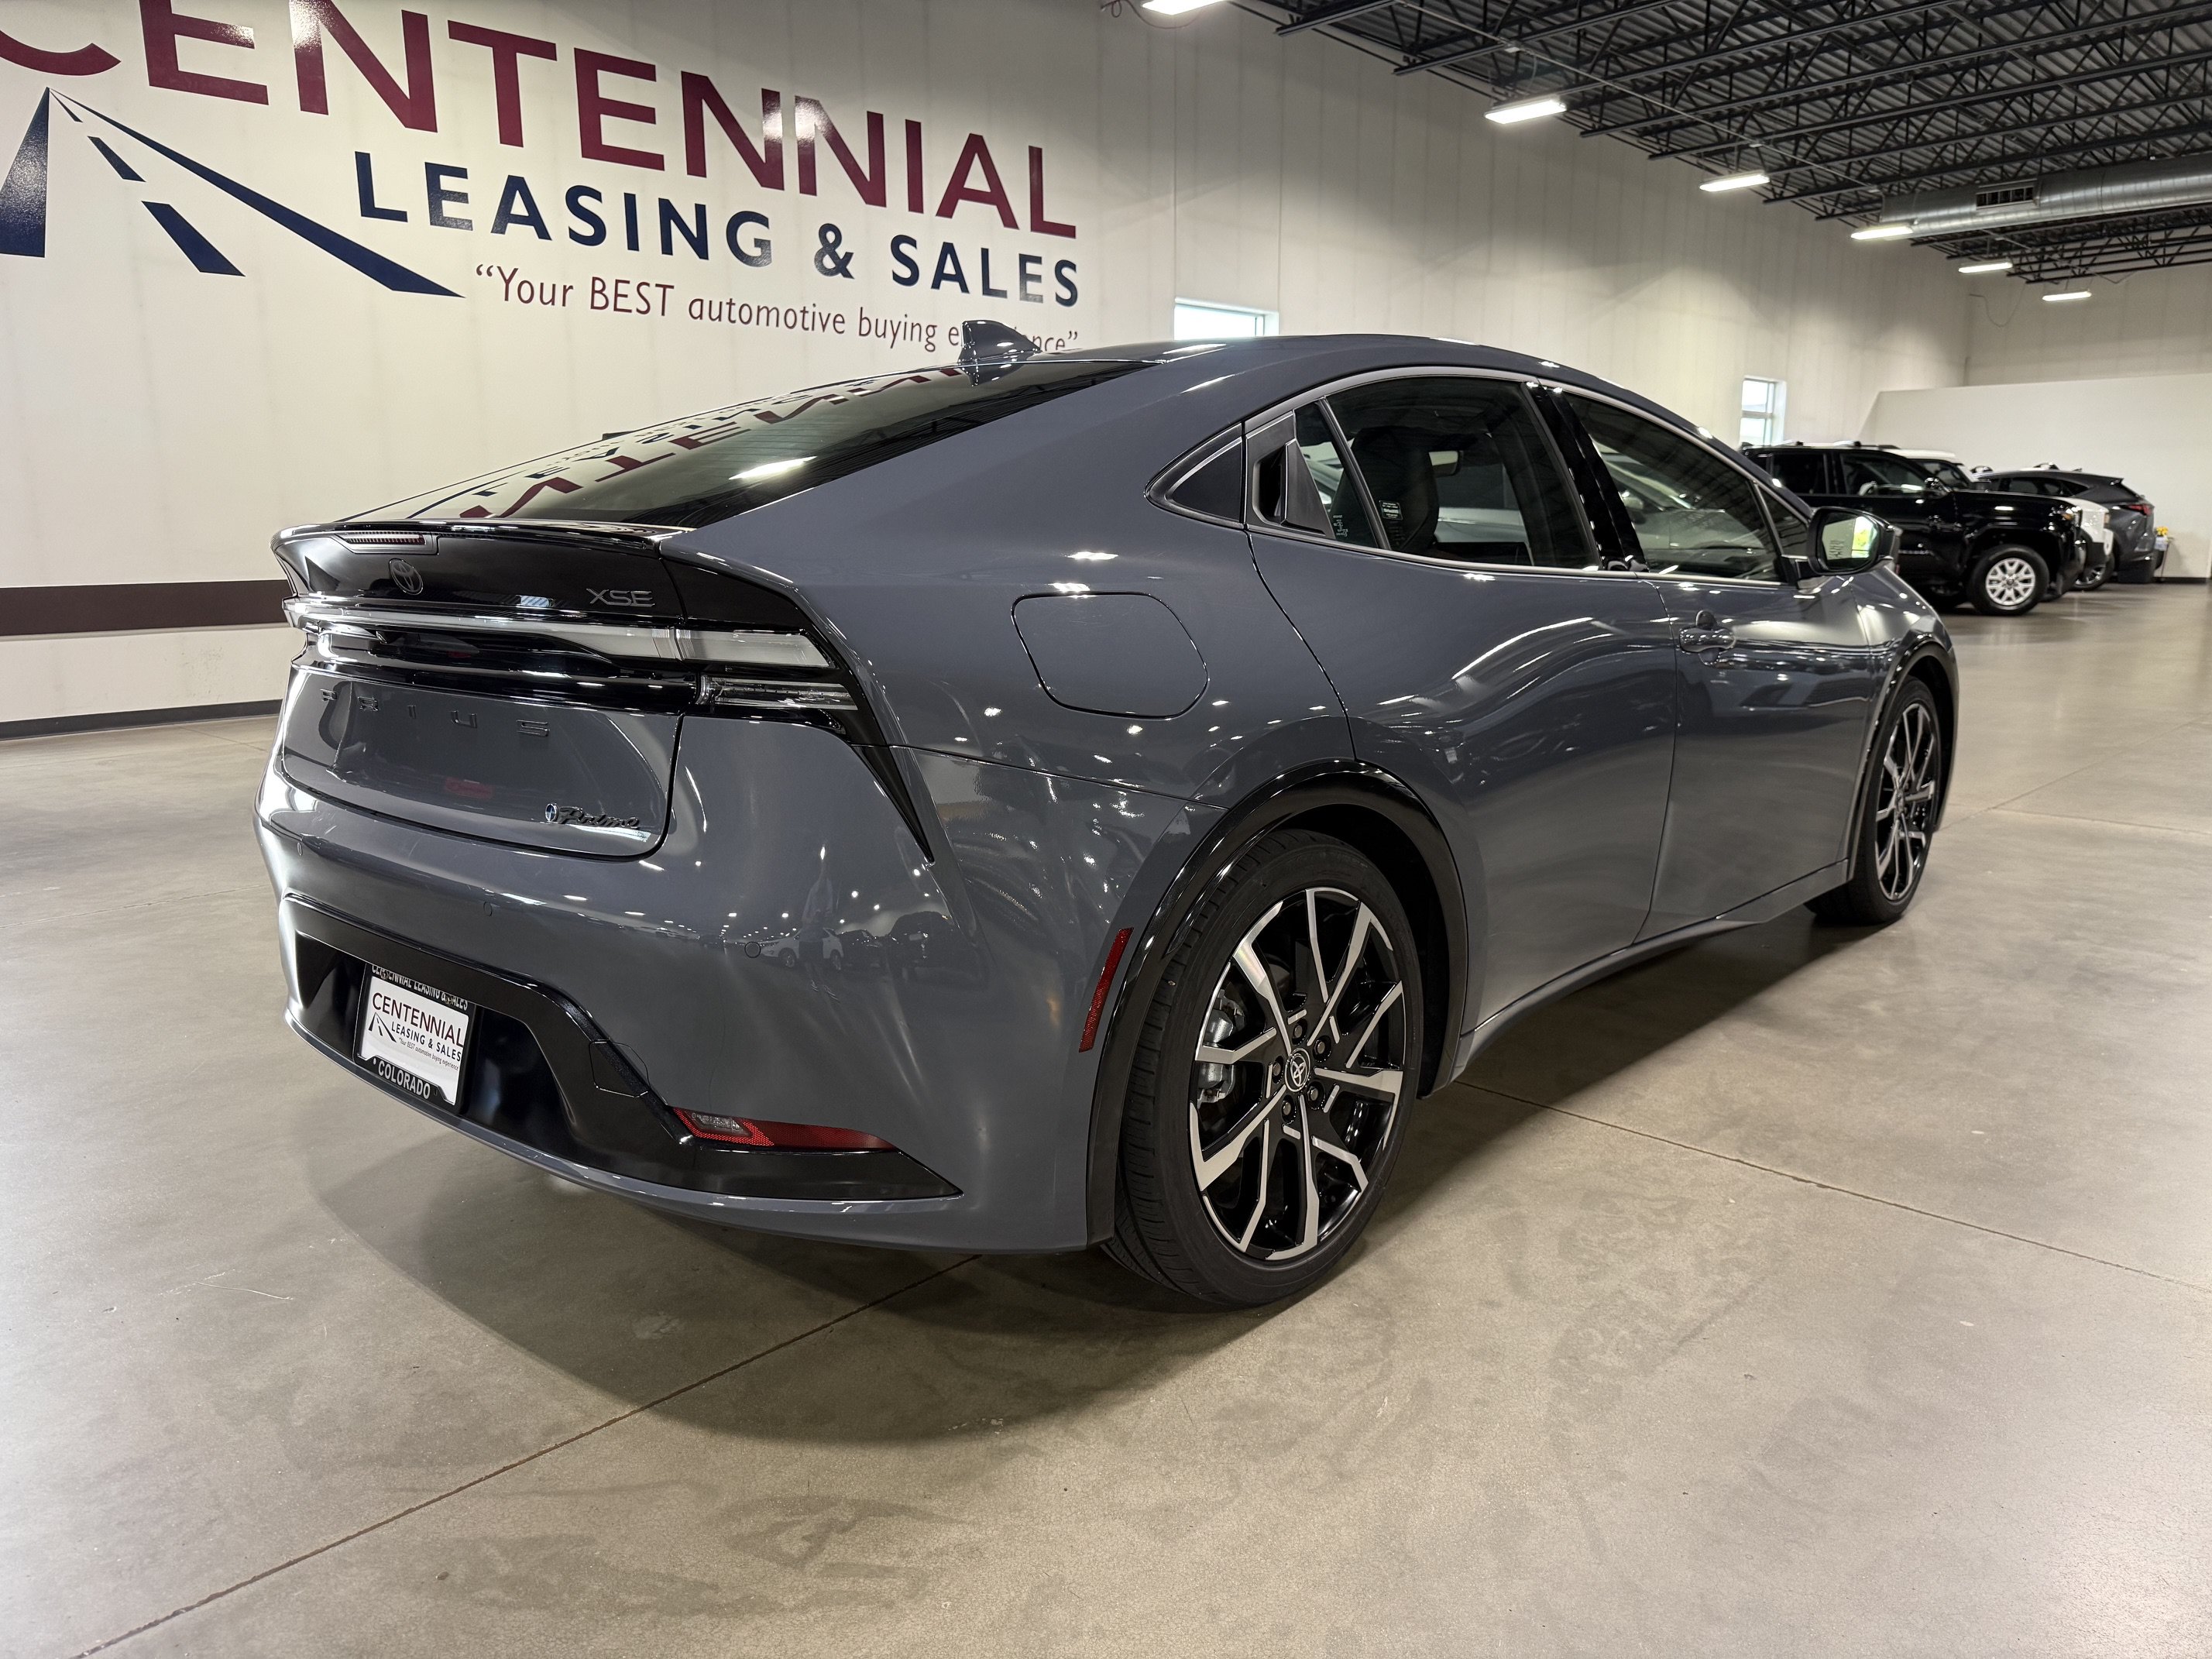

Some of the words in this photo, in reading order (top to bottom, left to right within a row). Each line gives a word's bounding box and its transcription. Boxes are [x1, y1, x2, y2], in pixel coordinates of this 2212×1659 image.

[355, 151, 773, 267] LEASING
[814, 223, 855, 280] &
[890, 234, 1079, 307] SALES
[476, 264, 573, 307] “Your
[589, 276, 675, 316] BEST
[688, 294, 846, 335] automotive
[857, 307, 938, 352] buying
[586, 588, 655, 607] XSE
[320, 689, 550, 737] PRIUS
[557, 805, 640, 830] Prime
[373, 992, 465, 1047] CENTENNIAL
[391, 1021, 425, 1046] LEASING
[428, 1038, 433, 1049] &
[436, 1042, 462, 1062] SALES
[378, 1060, 431, 1100] COLORADO
